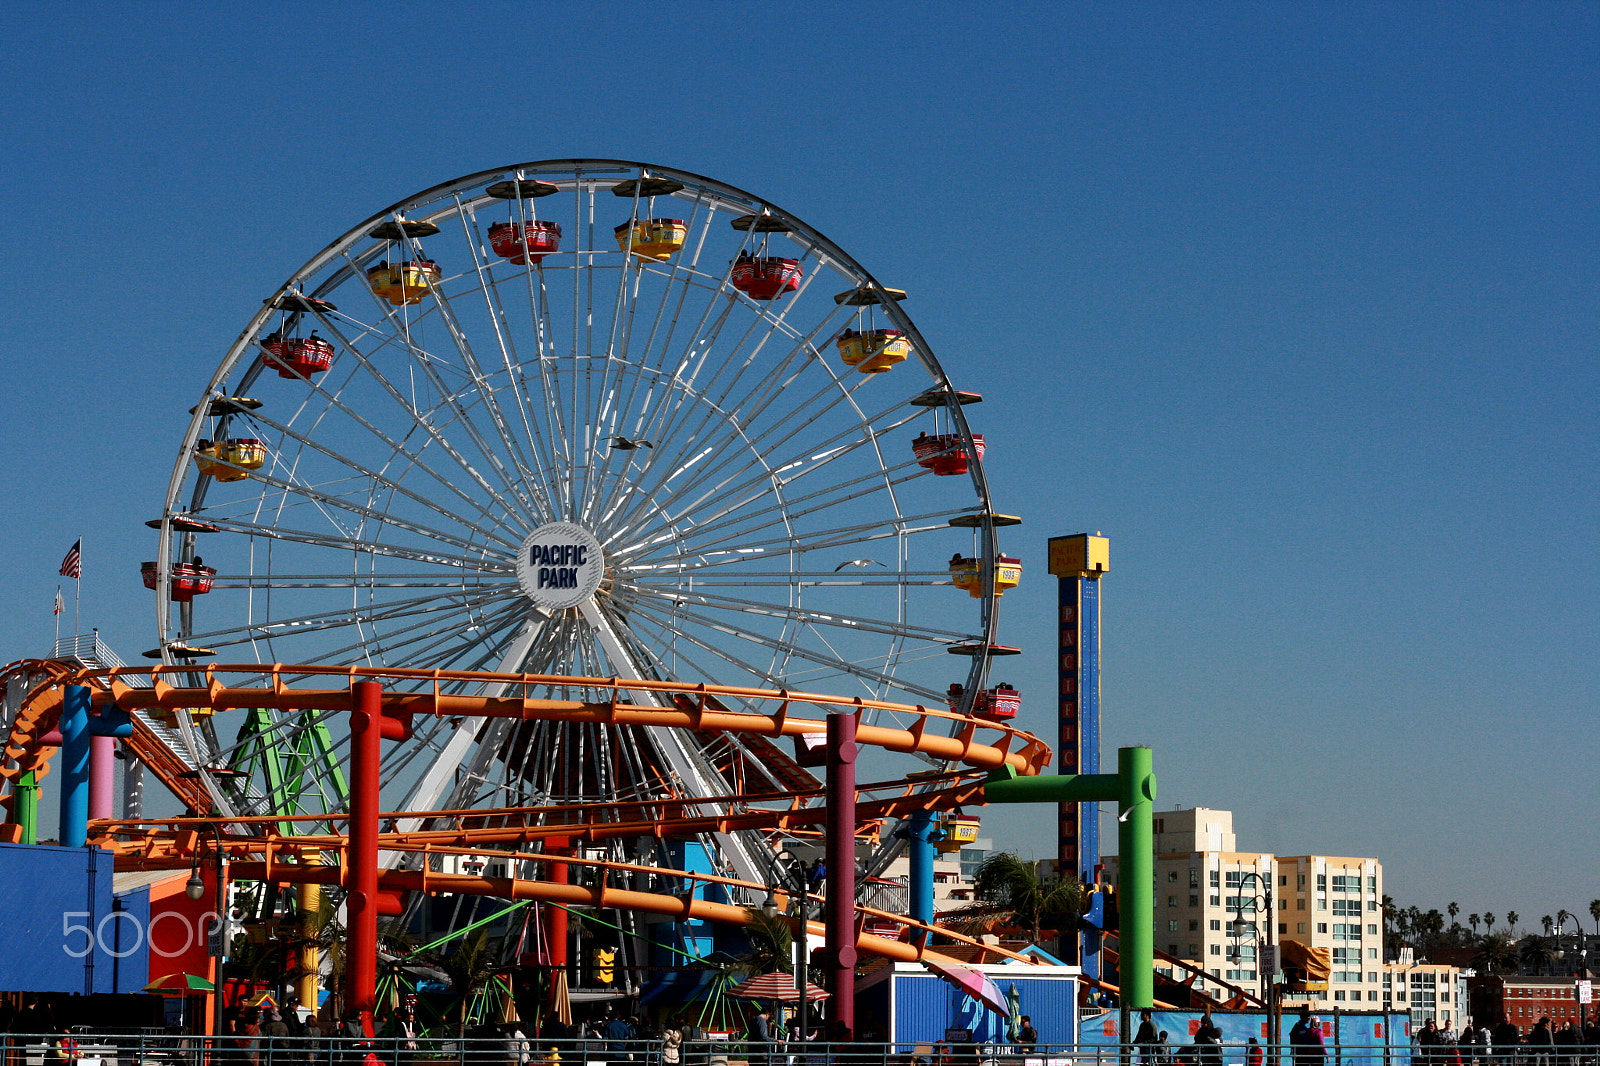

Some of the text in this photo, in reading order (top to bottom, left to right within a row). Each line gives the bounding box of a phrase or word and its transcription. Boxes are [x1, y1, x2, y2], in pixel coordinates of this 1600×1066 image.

[530, 544, 588, 567] PACIFIC
[537, 567, 579, 590] PARK
[1063, 606, 1075, 765] PACIFIC
